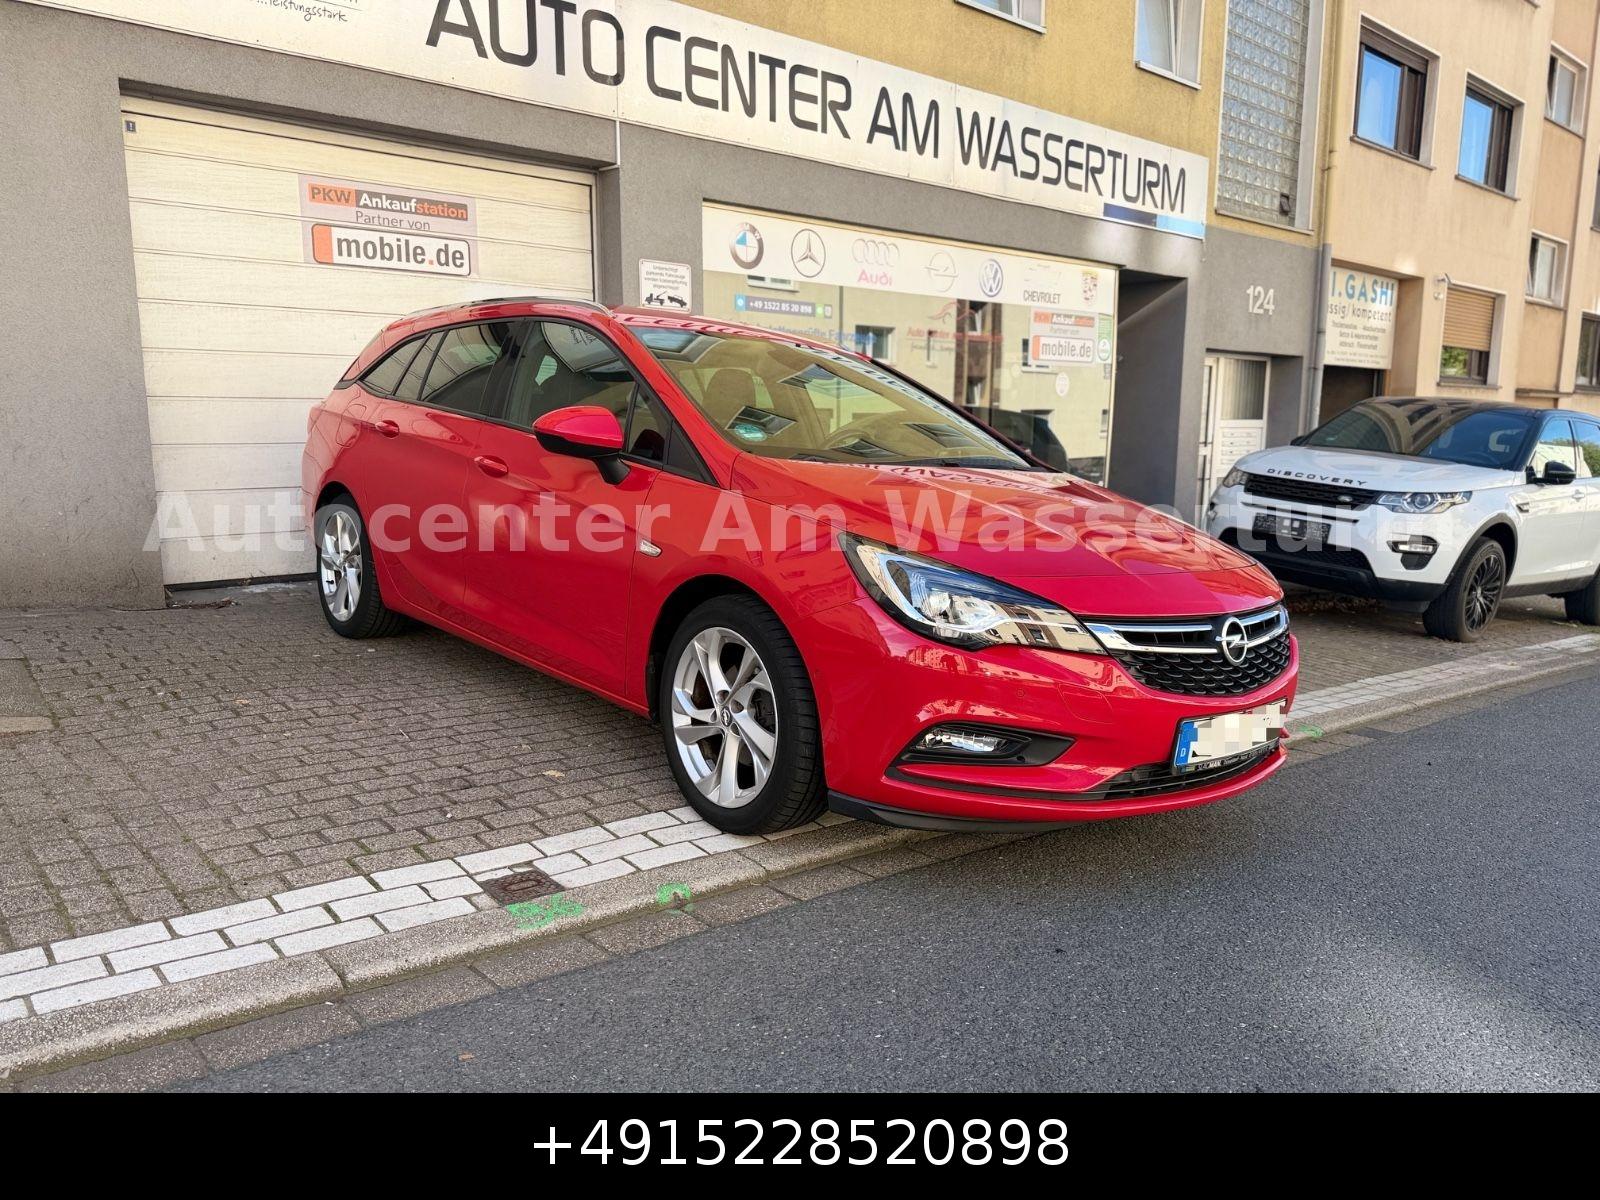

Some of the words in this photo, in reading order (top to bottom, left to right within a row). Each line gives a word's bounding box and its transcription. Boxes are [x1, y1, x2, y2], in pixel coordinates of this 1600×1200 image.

[426, 0, 625, 87] AUTO
[645, 25, 852, 140] CENTER
[866, 86, 940, 159] AM
[956, 107, 1186, 214] WASSERTURM
[311, 186, 351, 204] PKW
[359, 192, 467, 219] Ankaufstation
[355, 211, 404, 228] Partner
[408, 220, 431, 231] von
[336, 236, 465, 269] mobile.de
[857, 269, 893, 286] Audi
[1023, 290, 1061, 305] CHEVROLET
[1246, 285, 1276, 316] 124
[1352, 303, 1392, 322] kompetent
[1041, 341, 1092, 358] mobile.de
[1266, 468, 1367, 486] DISCOVERY
[1180, 747, 1186, 757] D
